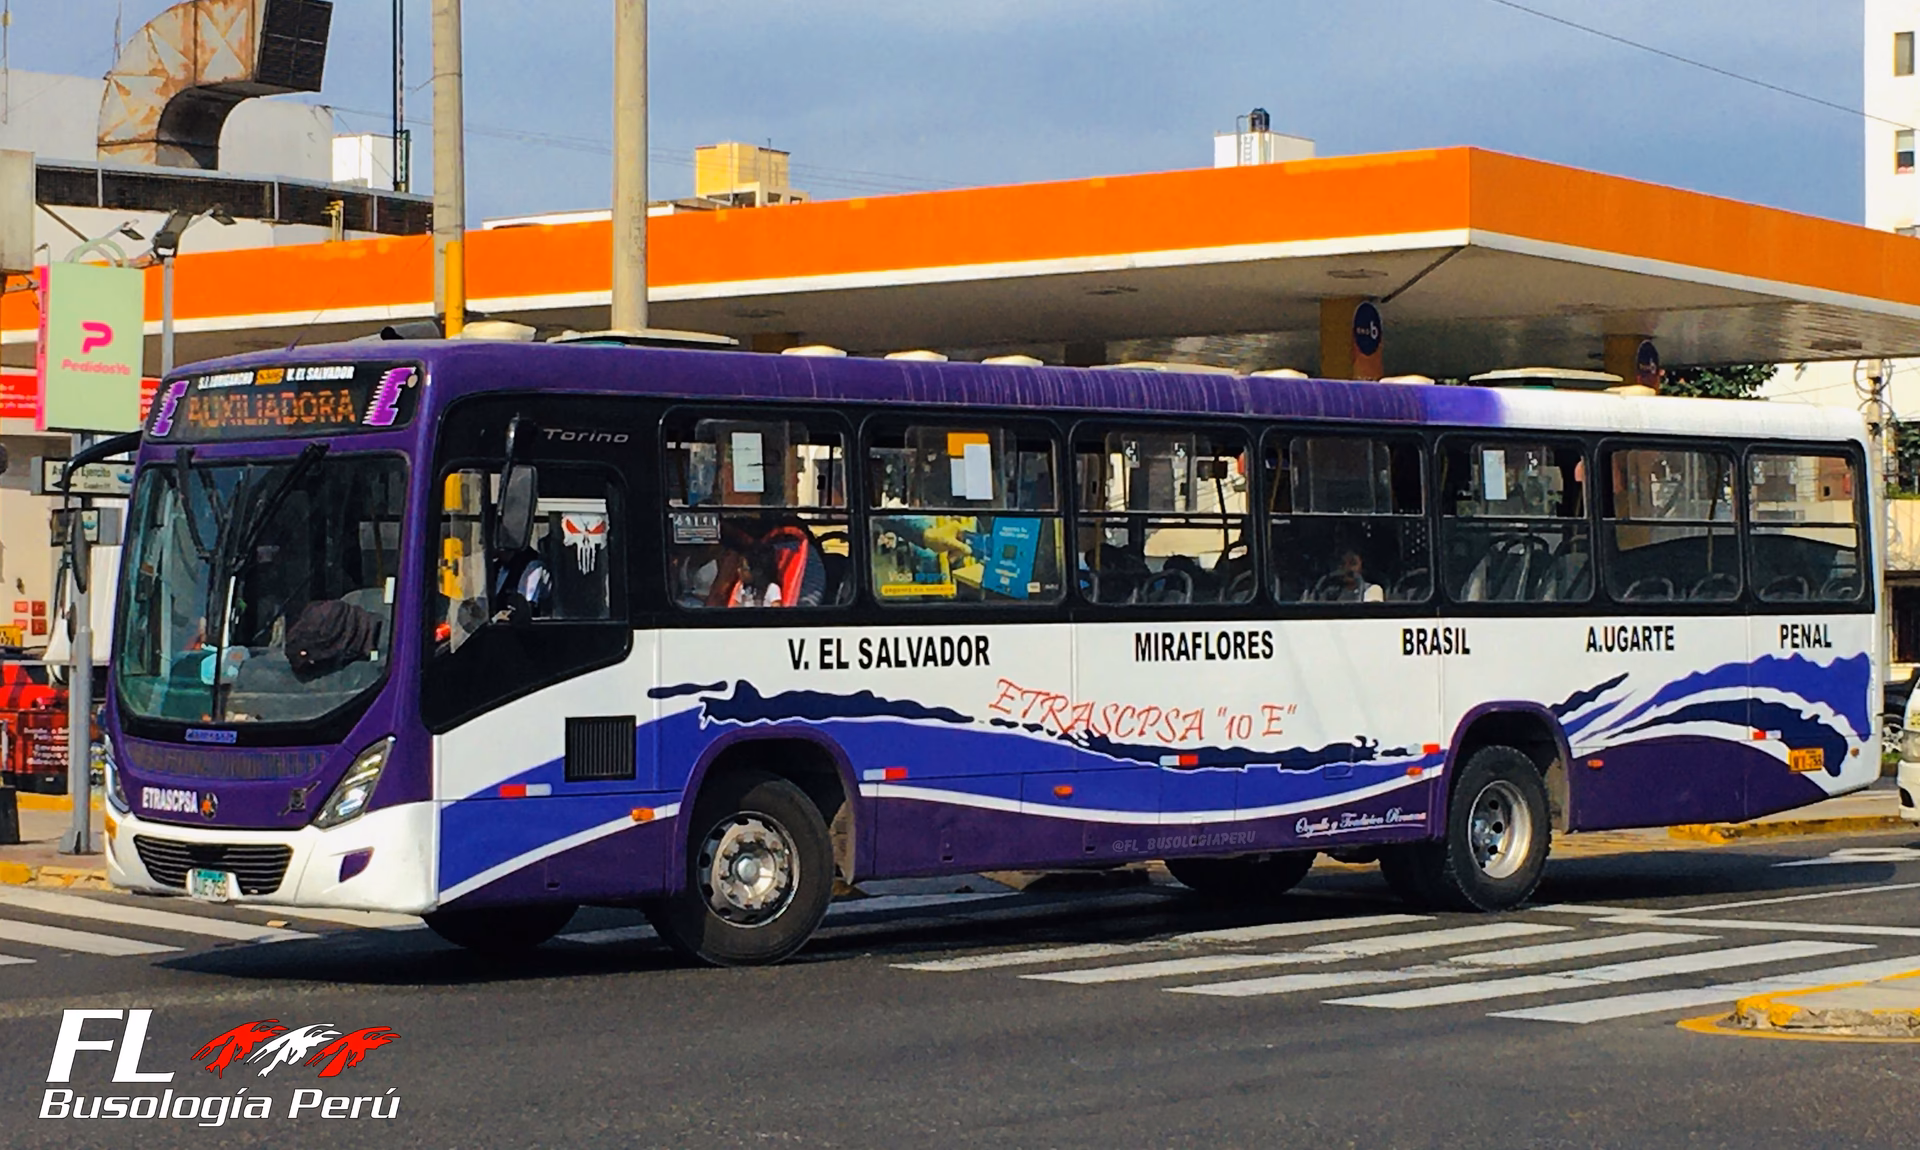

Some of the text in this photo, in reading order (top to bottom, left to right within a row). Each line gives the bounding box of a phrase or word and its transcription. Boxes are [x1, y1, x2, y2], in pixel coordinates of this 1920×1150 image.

[61, 357, 131, 376] PedidosYa
[306, 366, 355, 381] SALVADOR
[187, 389, 357, 428] AUXILIADORA
[543, 428, 630, 443] Torino
[1135, 630, 1274, 662] MIRAFLORES
[1402, 627, 1471, 656] BRASIL
[1586, 625, 1675, 653] A.UGARTE
[1779, 623, 1832, 649] PENAL
[788, 635, 990, 669] V. EL SALVADOR
[988, 678, 1205, 743] ETRASCPSA
[142, 786, 199, 814] ETRASCPSA
